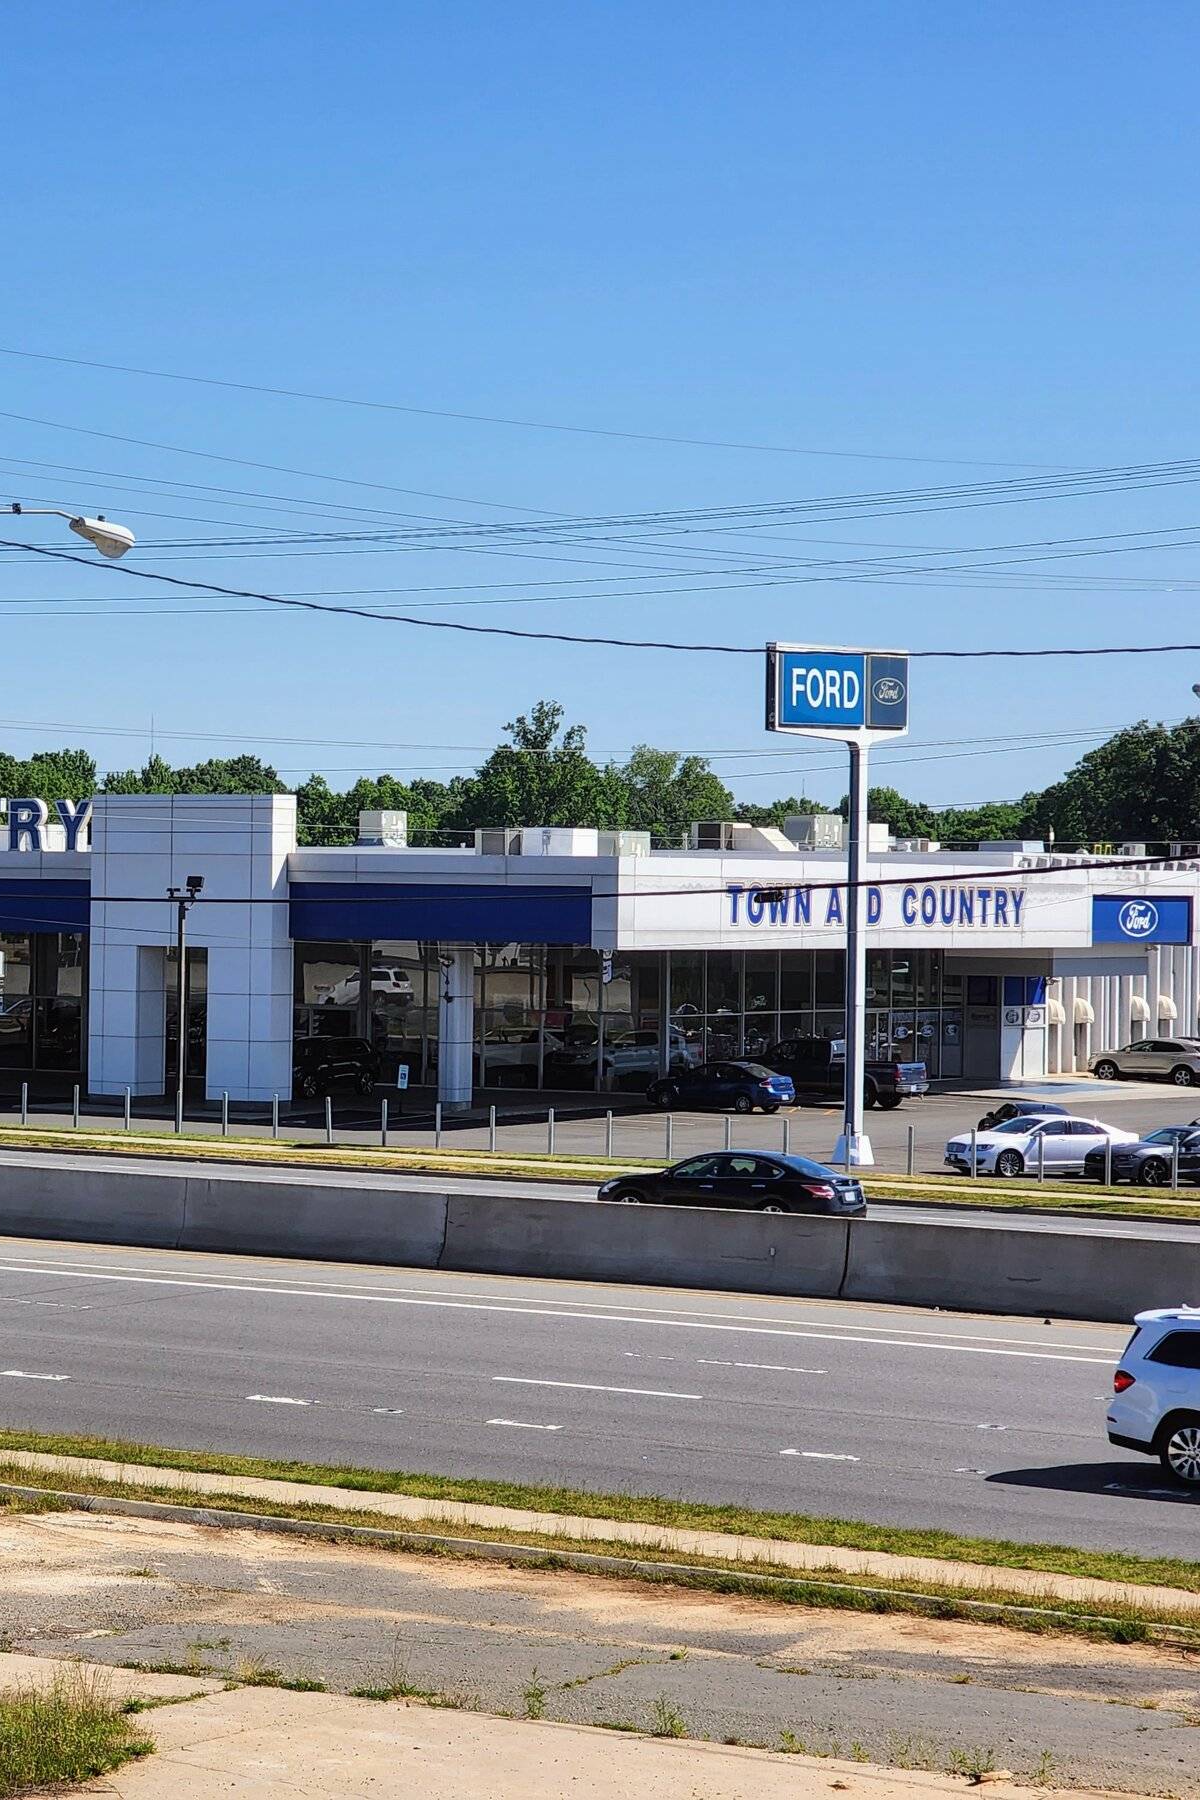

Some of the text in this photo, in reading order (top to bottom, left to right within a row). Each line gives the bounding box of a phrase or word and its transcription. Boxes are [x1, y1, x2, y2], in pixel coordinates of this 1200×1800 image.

[792, 668, 860, 709] FORD
[878, 681, 899, 699] Ford
[726, 881, 1027, 928] TOWN AD COUNTRY
[1126, 904, 1151, 930] Ford
